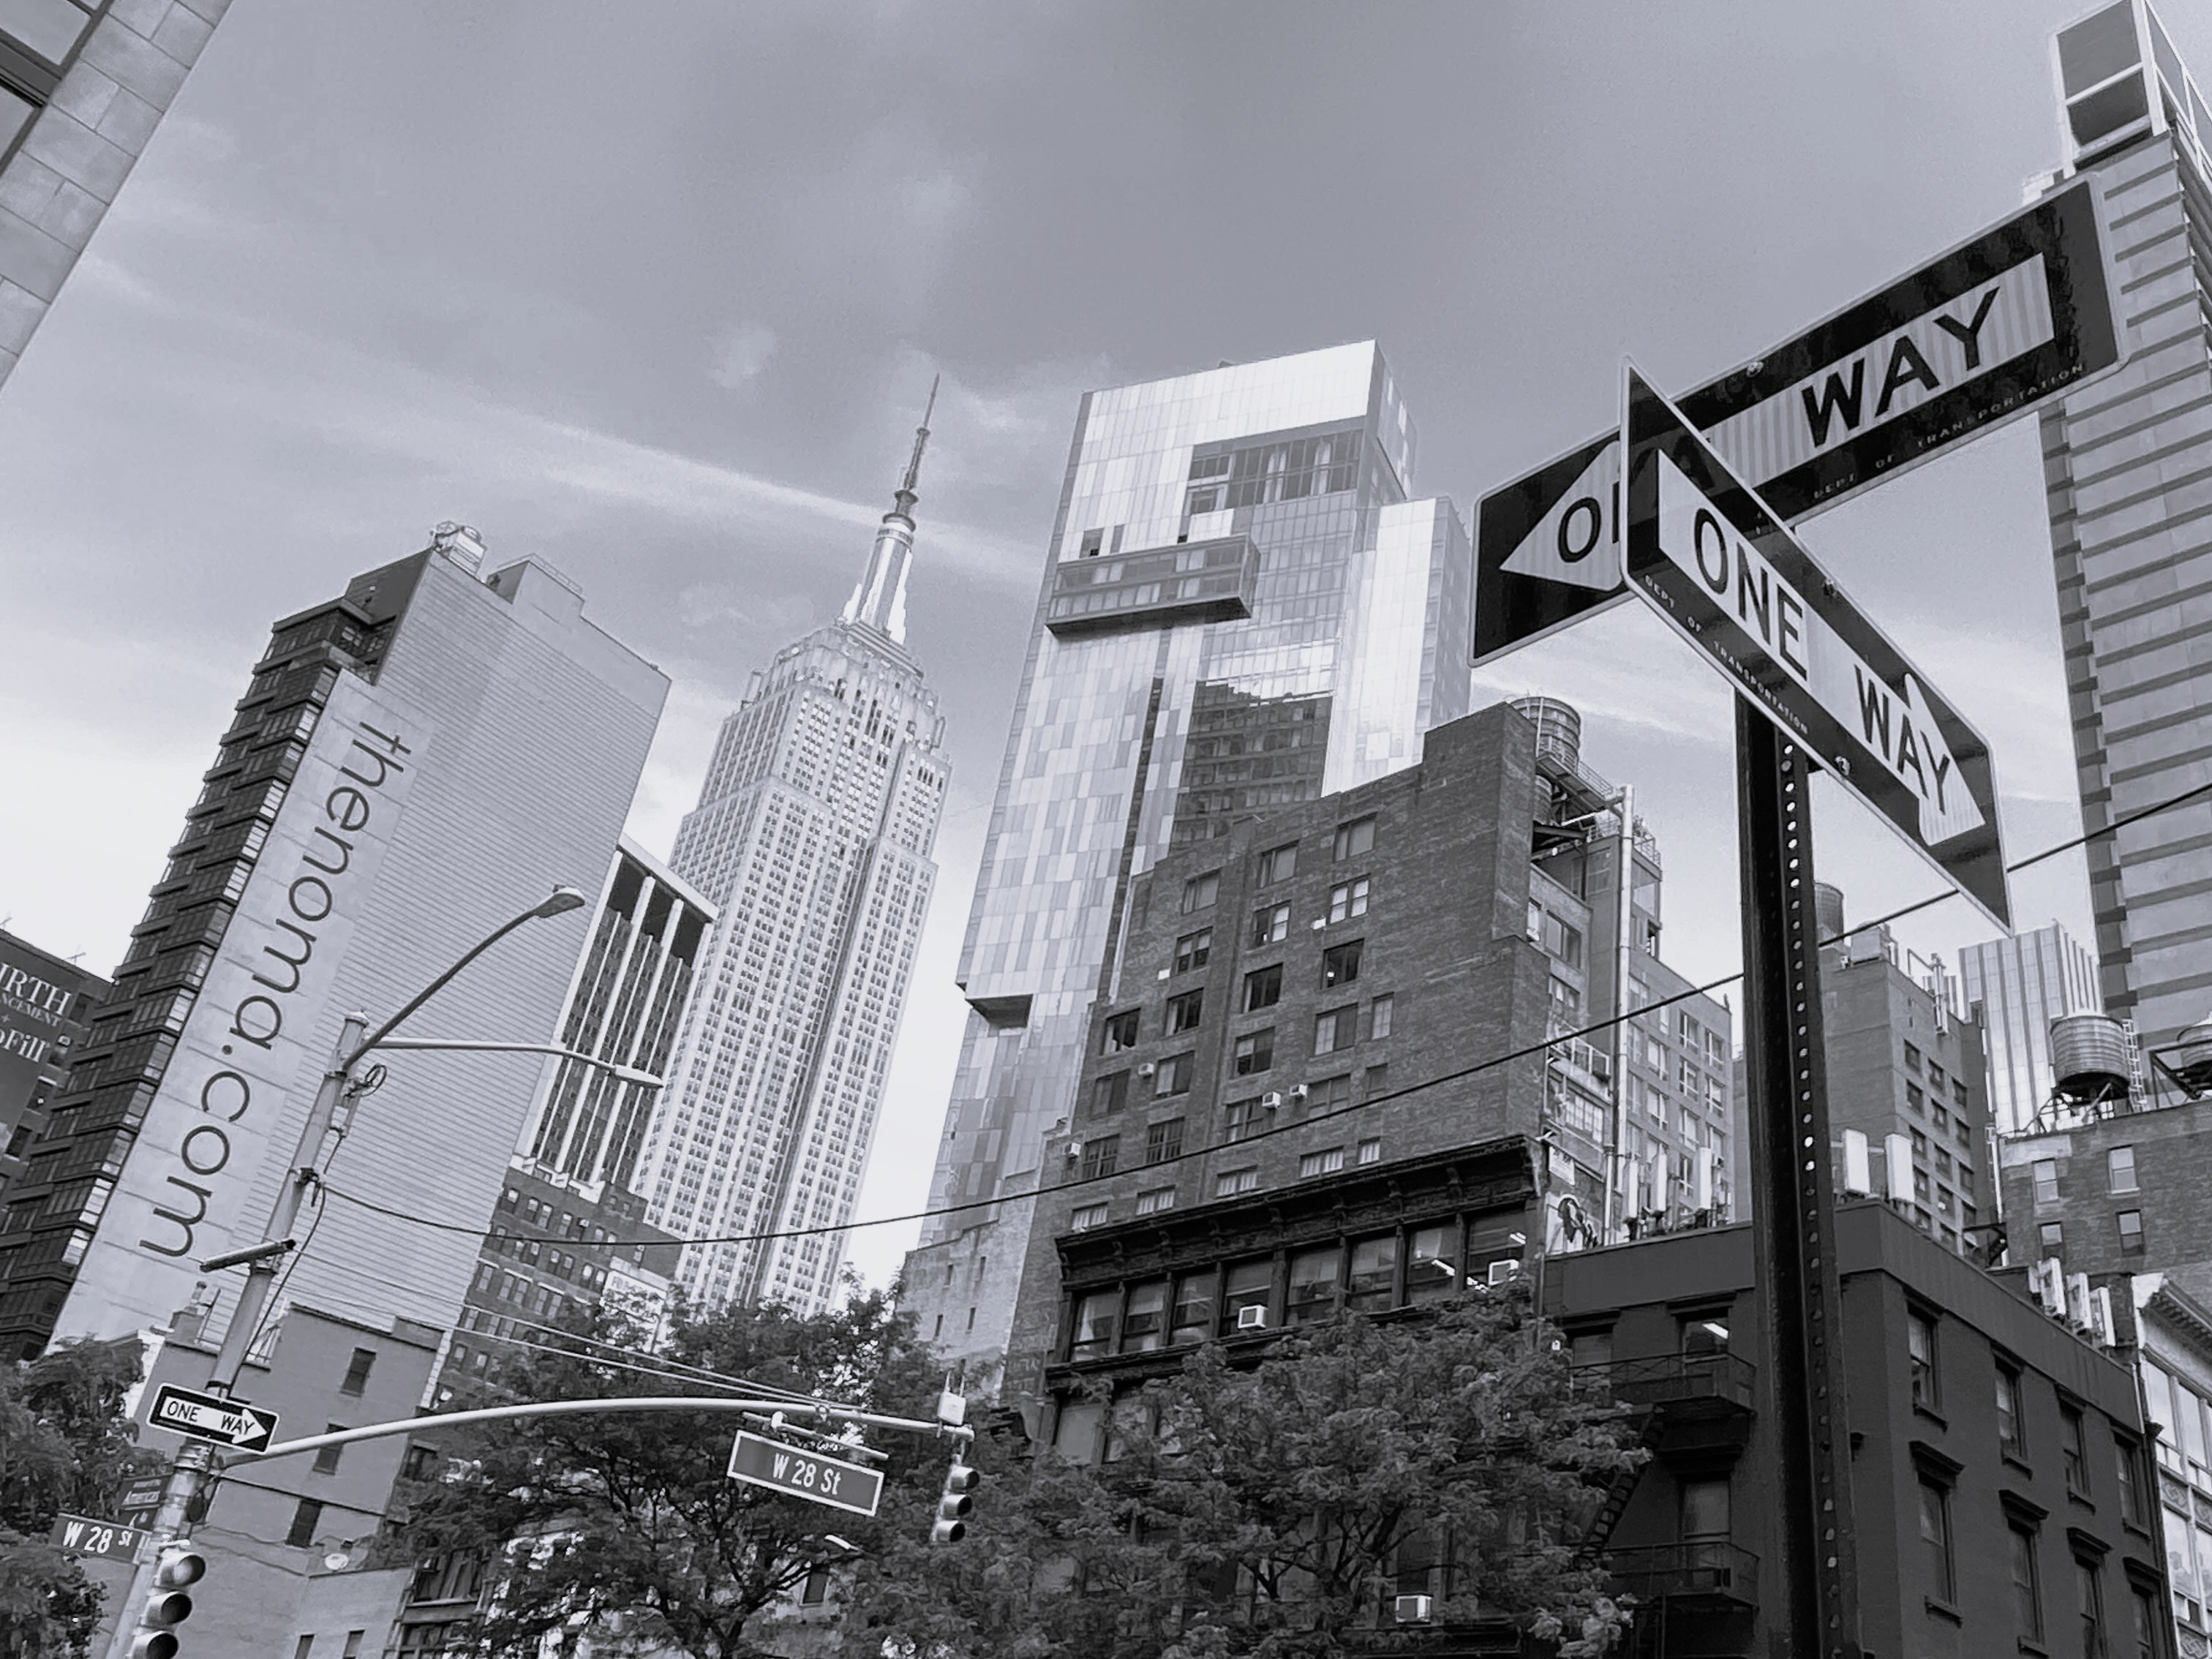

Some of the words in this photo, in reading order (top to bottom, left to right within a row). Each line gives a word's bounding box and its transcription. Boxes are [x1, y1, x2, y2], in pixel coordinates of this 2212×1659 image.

[1801, 285, 2001, 448] WAY
[1917, 363, 2083, 448] TRANSPORTATION
[1693, 507, 1807, 682] ONE
[1854, 663, 1950, 816] WAY
[1714, 640, 1808, 734] TRANSPORTATION
[139, 721, 411, 1257] thenoma.com
[167, 1400, 202, 1423] ONE
[220, 1414, 255, 1435] WAY
[772, 1452, 790, 1480] W
[790, 1459, 817, 1488] 28
[821, 1468, 842, 1495] St
[63, 1521, 85, 1549] W
[83, 1526, 113, 1554] 28
[118, 1530, 133, 1547] St
